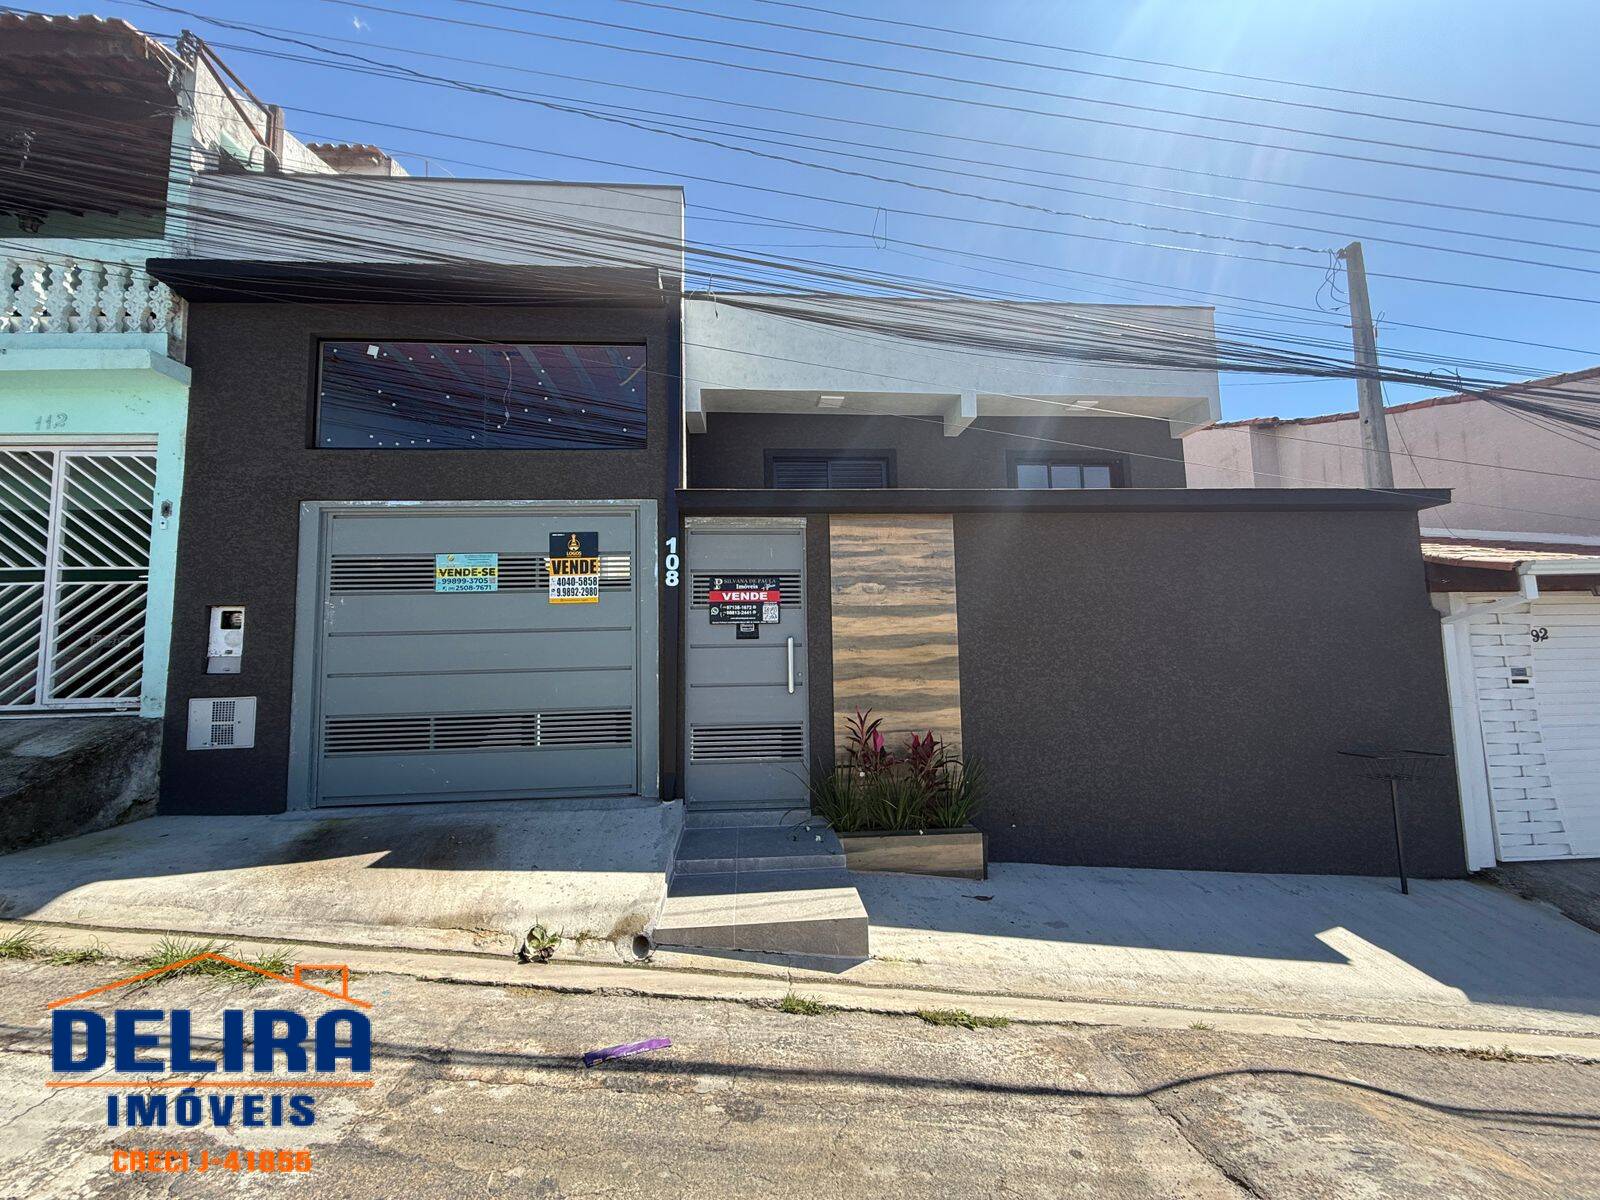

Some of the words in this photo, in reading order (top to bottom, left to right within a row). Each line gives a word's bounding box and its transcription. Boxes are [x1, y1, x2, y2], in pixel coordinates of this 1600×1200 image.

[551, 559, 598, 575] VENDE
[665, 536, 680, 587] 108
[438, 567, 496, 577] VENDE-SE
[441, 577, 489, 585] 99899-3705
[556, 576, 598, 587] 4040-5858
[721, 591, 768, 601] VENDE
[1530, 627, 1549, 643] 92
